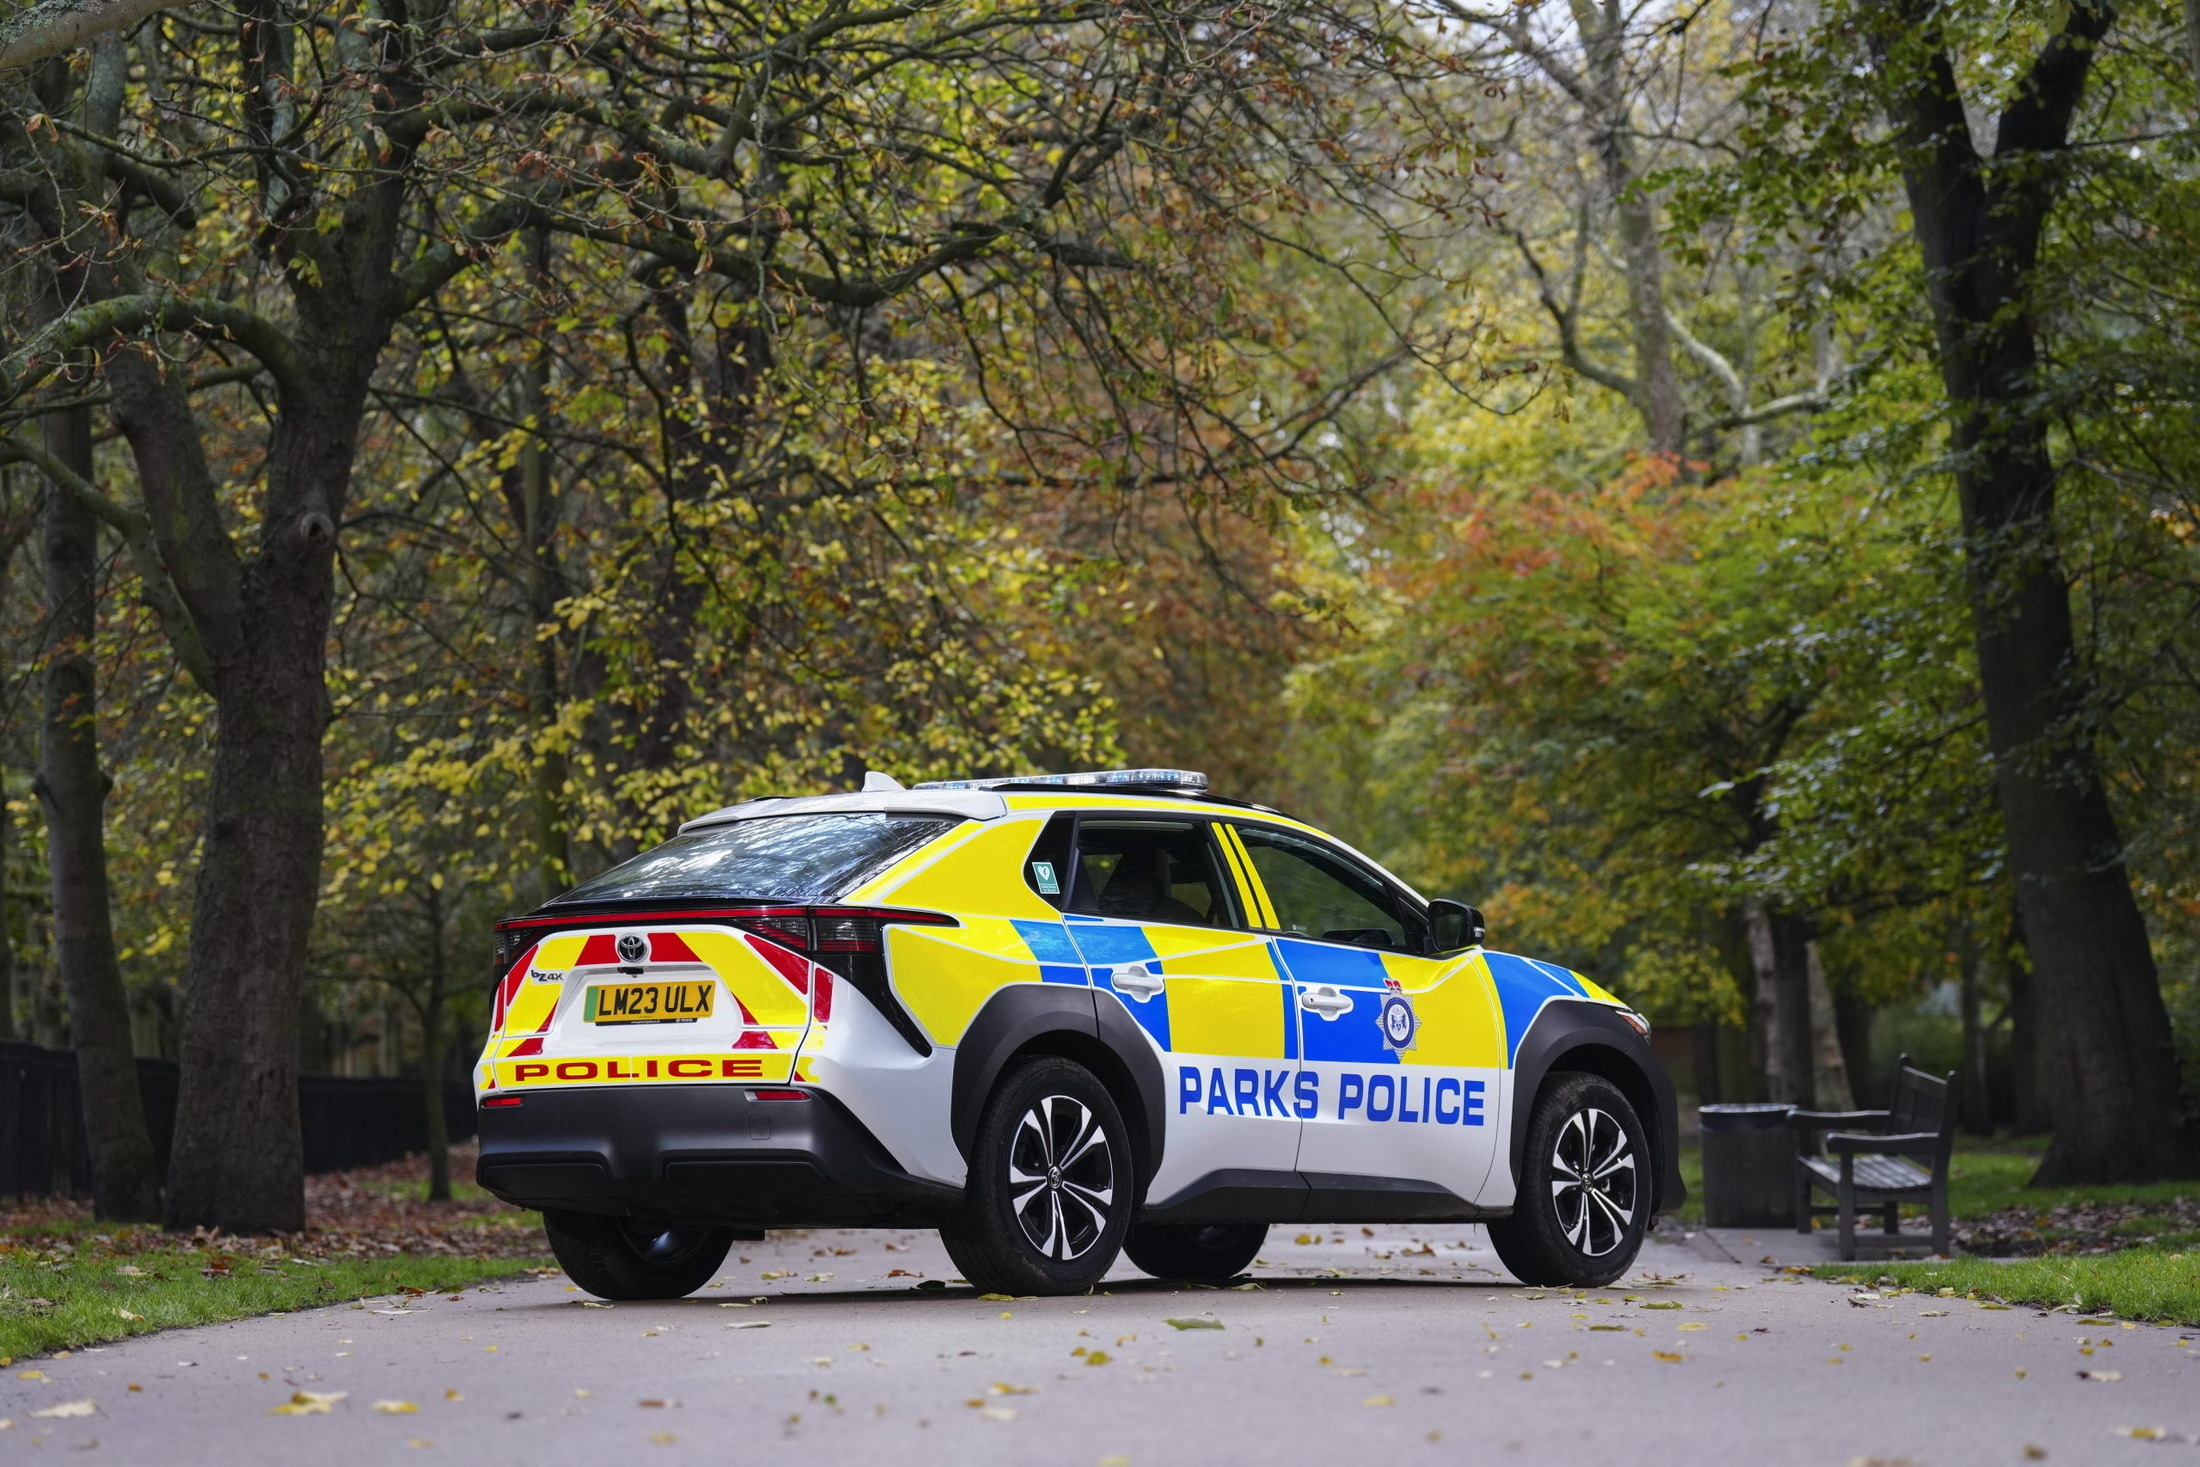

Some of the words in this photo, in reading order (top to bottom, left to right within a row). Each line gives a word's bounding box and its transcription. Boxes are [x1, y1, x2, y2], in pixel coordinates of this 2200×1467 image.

[598, 987, 659, 1016] LM23
[664, 985, 712, 1013] ULX
[515, 1059, 763, 1082] POLICE
[1179, 1066, 1319, 1119] PARKS
[1337, 1073, 1485, 1126] POLICE
